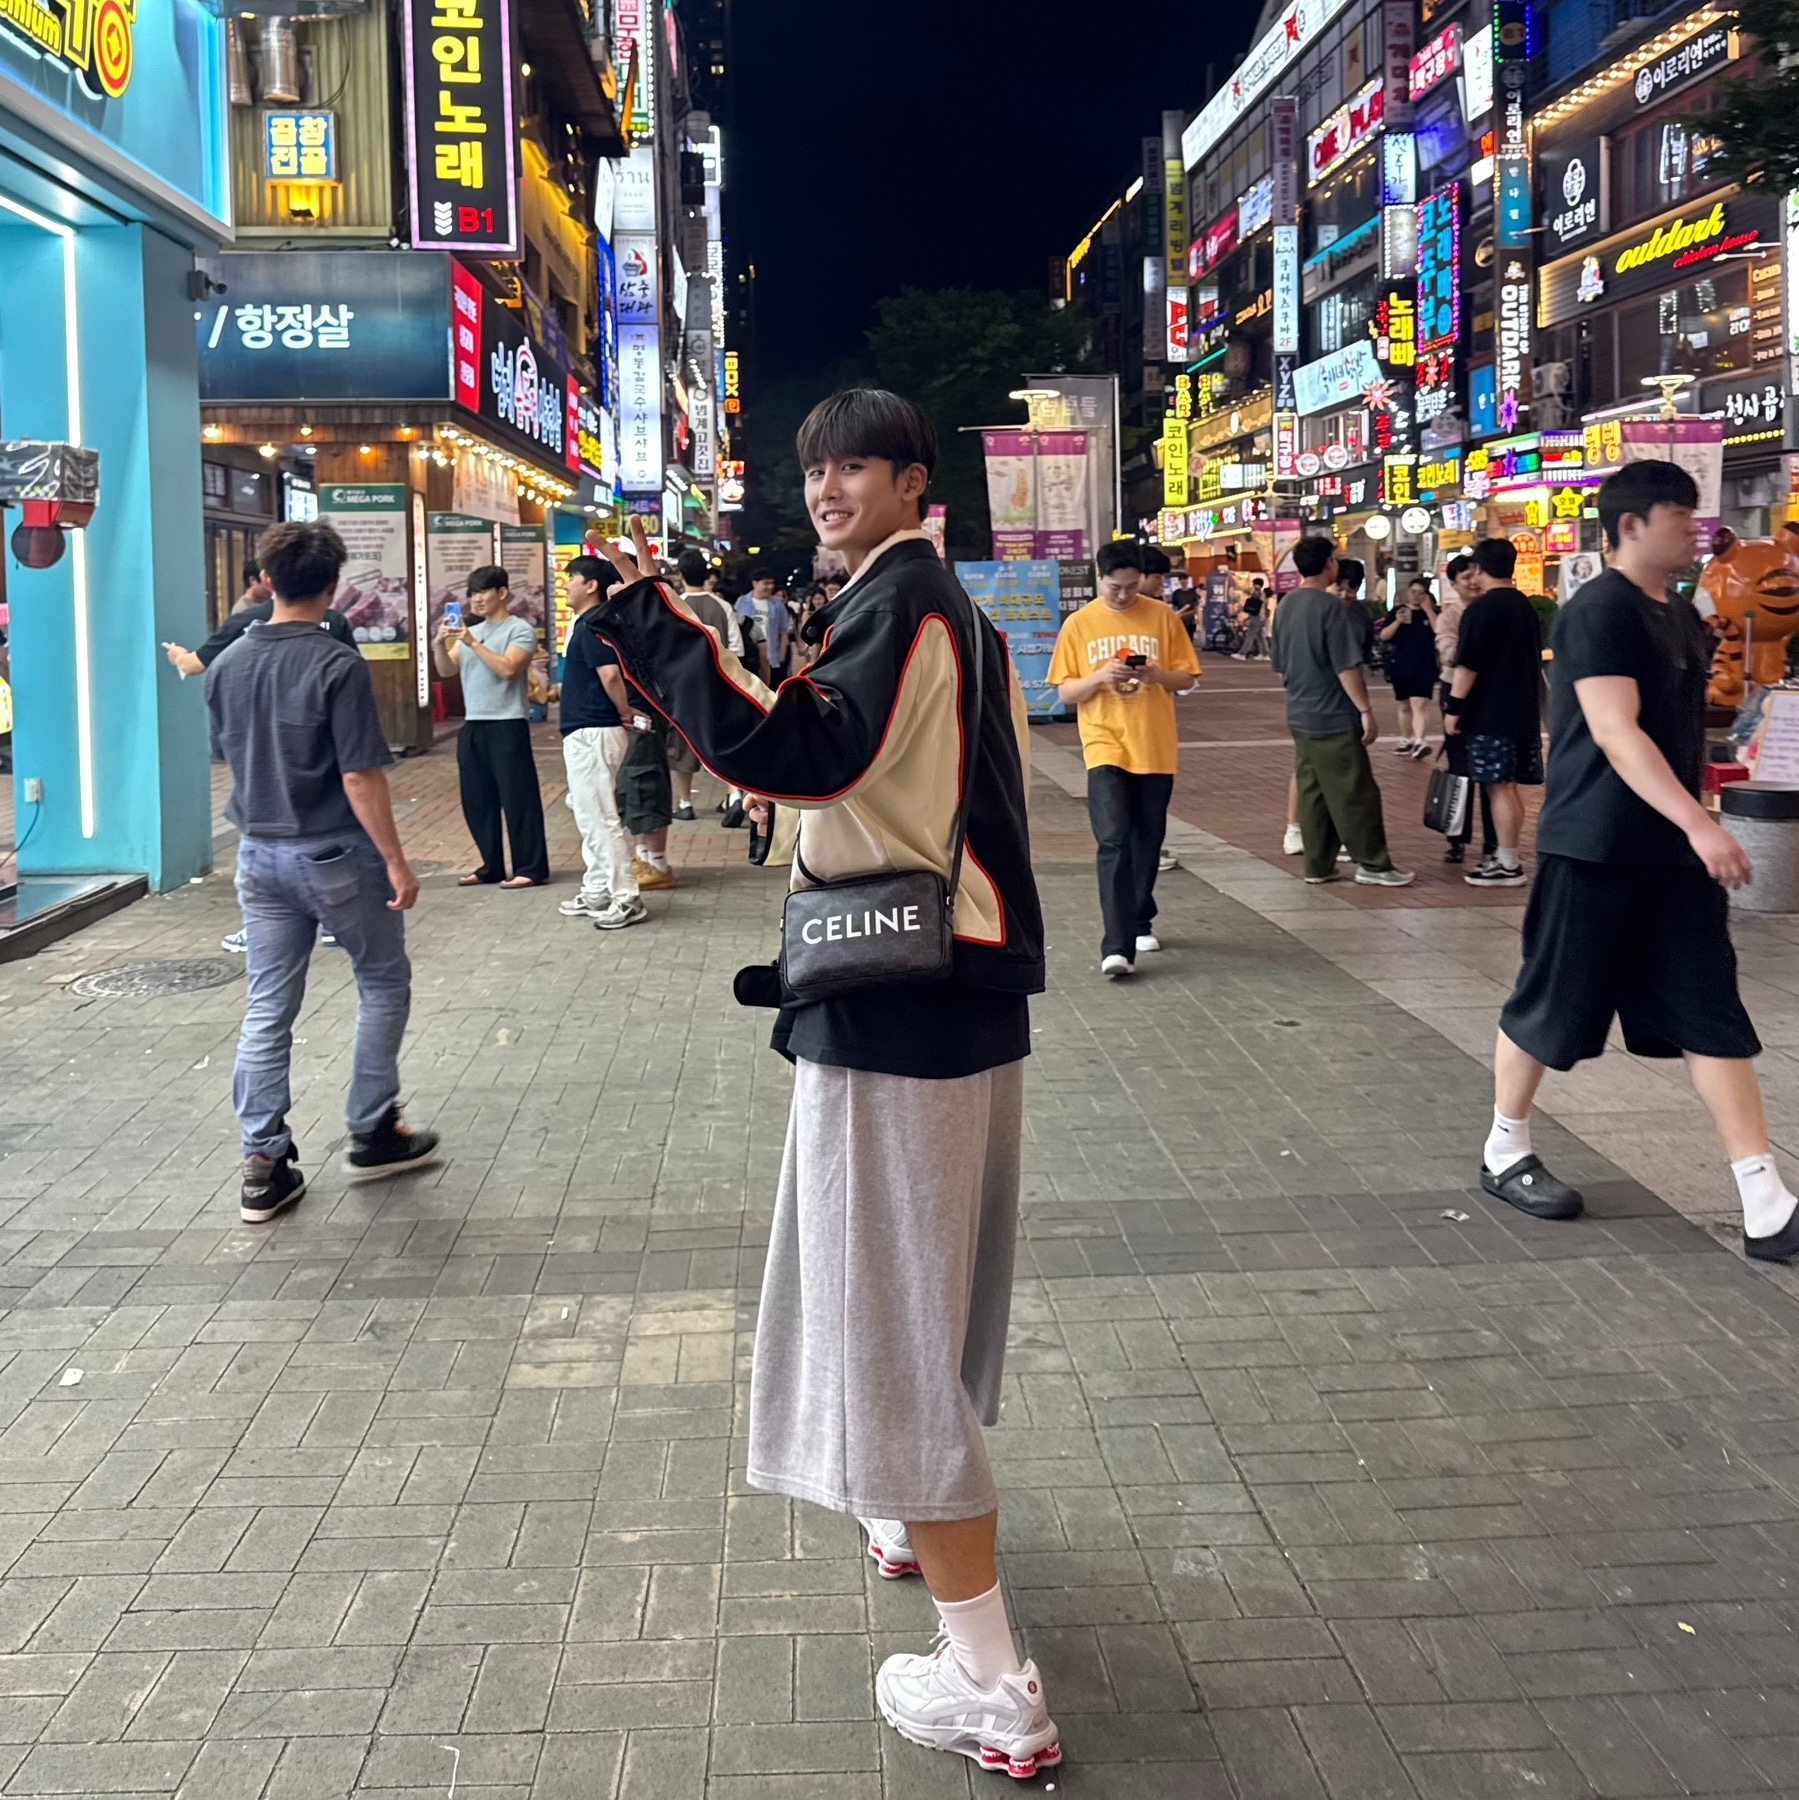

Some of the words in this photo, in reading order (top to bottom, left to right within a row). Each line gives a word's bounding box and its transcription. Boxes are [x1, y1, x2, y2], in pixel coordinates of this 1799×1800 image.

[458, 206, 493, 233] B1
[1616, 203, 1725, 274] outdark
[234, 304, 354, 349] 항정살
[1280, 337, 1292, 347] 2F
[1388, 292, 1416, 367] 노래빠
[1500, 284, 1521, 391] OUTDARK
[1167, 425, 1184, 496] 코인노래
[346, 495, 371, 504] MEGA
[372, 495, 395, 504] PORK
[1087, 635, 1159, 665] CHICAGO
[802, 906, 921, 945] CELINE
